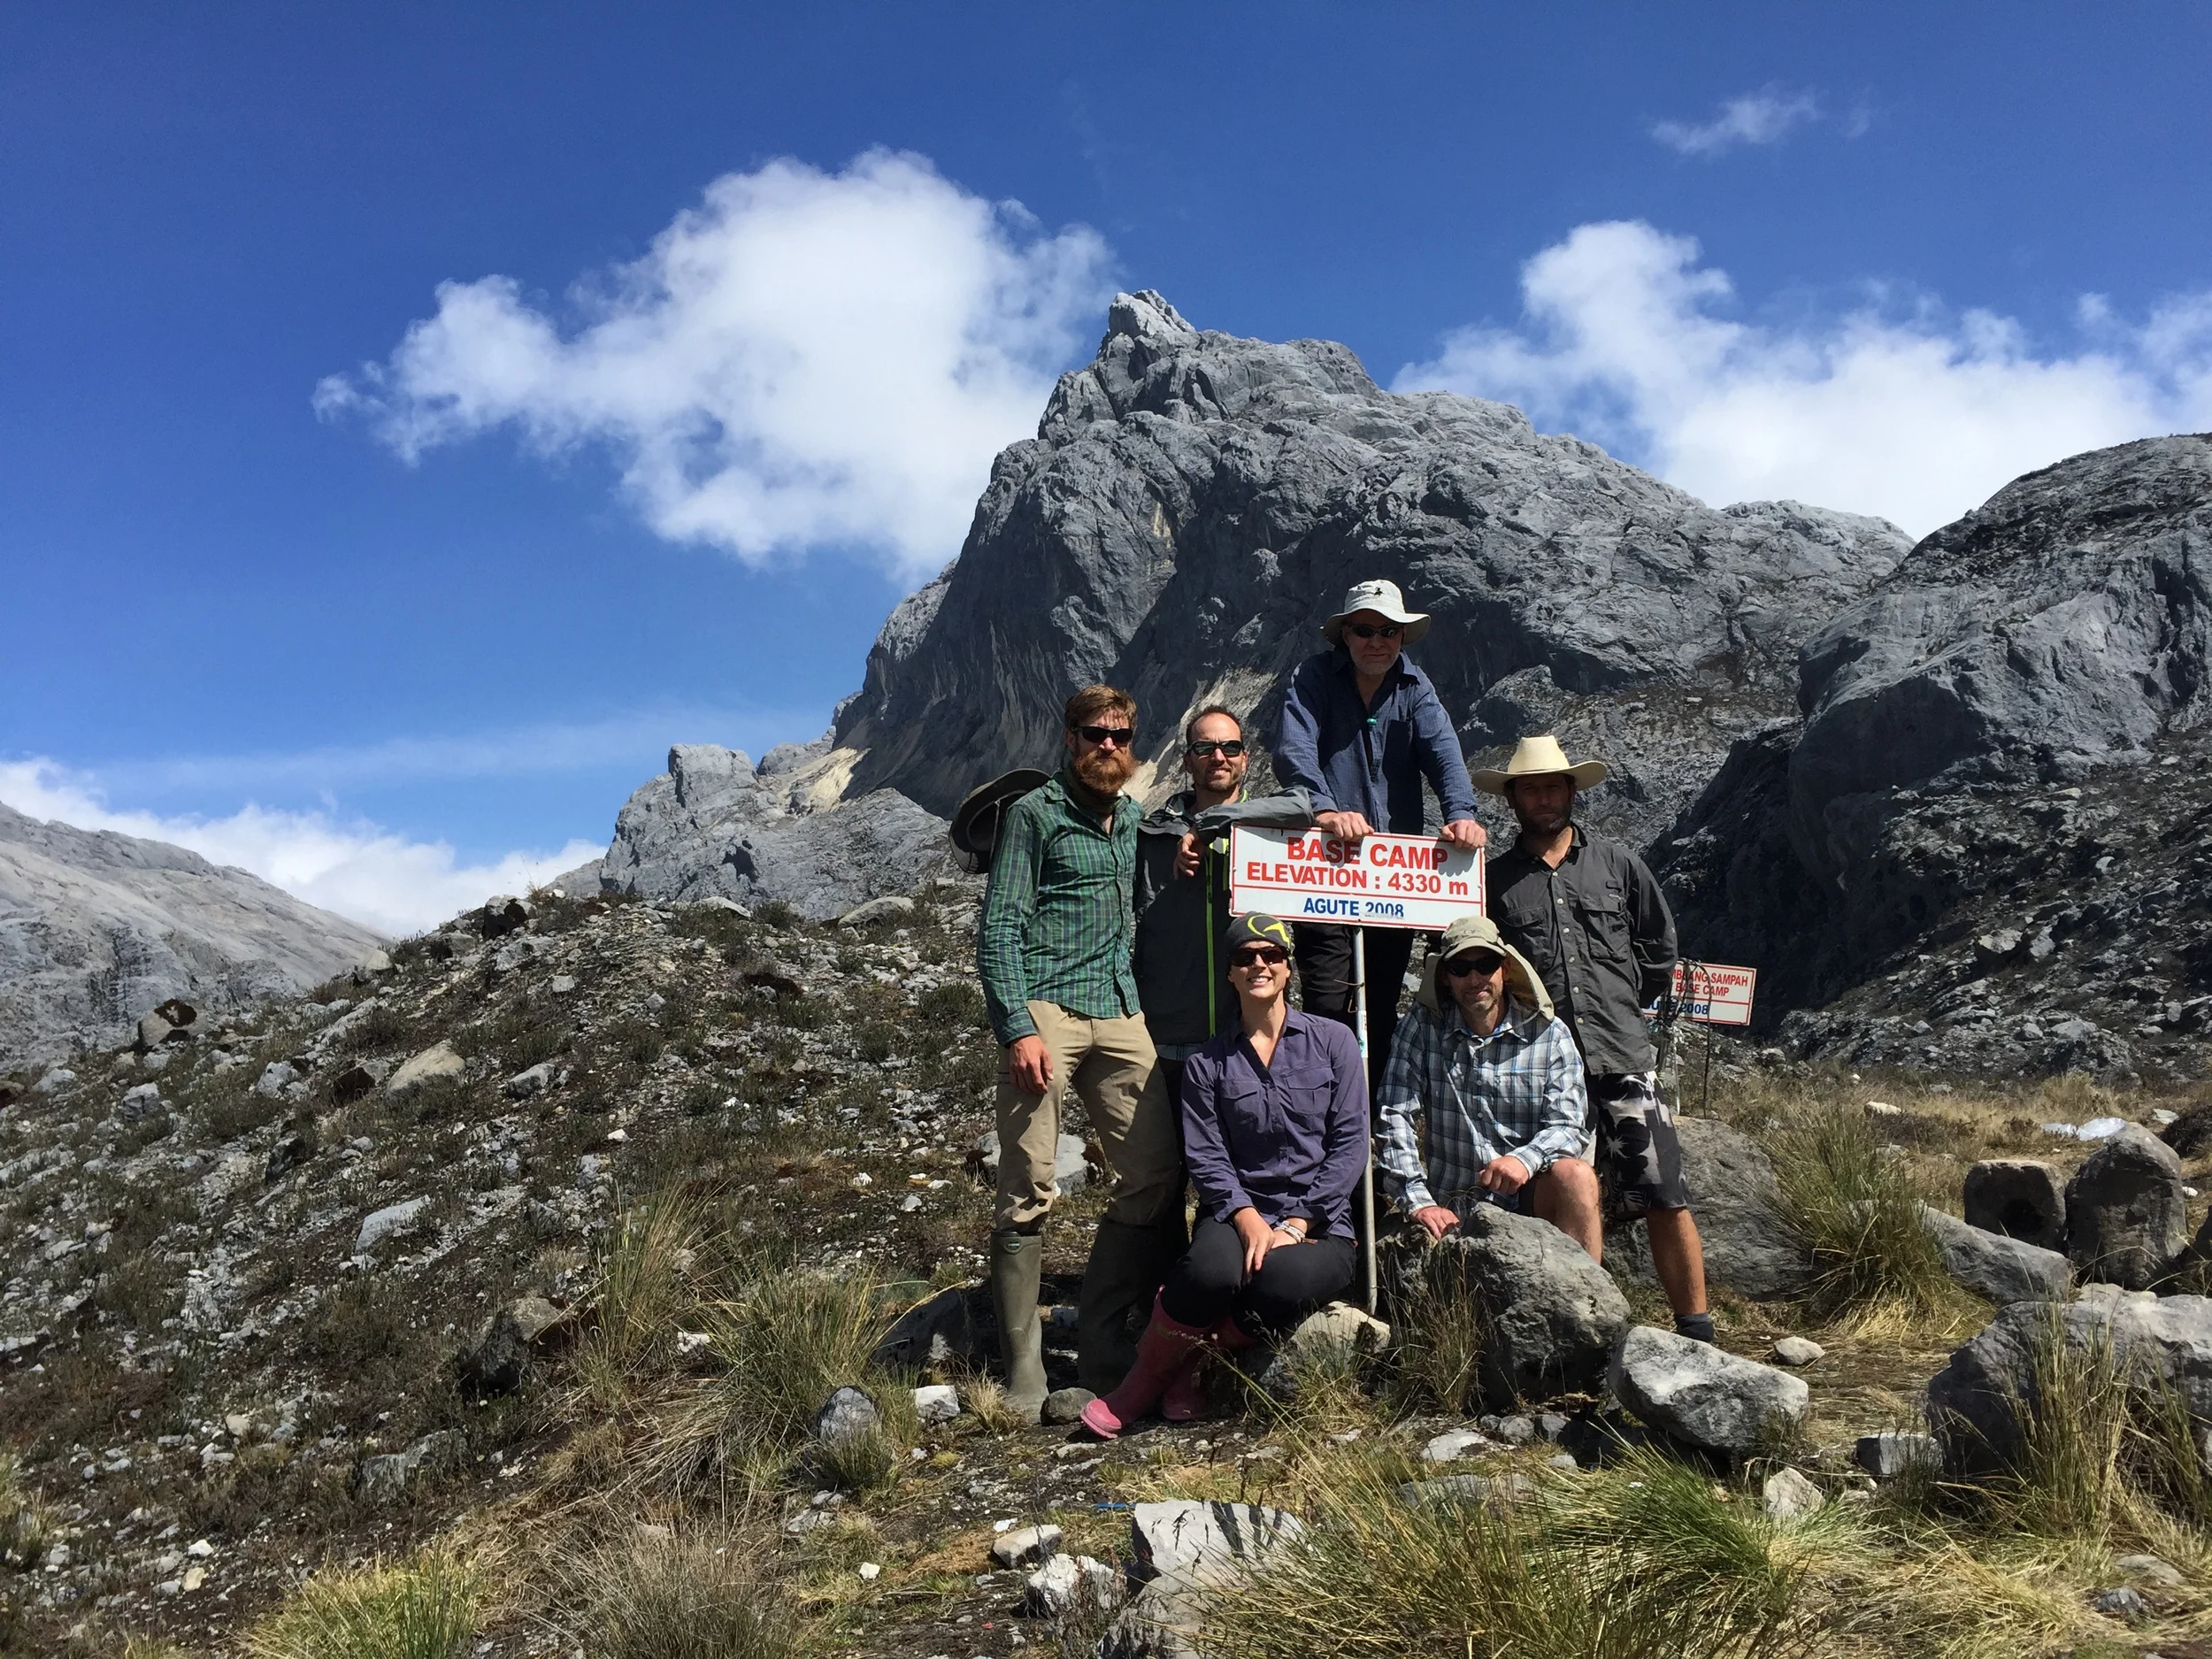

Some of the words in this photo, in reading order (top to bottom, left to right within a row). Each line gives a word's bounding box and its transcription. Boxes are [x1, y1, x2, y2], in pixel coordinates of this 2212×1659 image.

[1287, 836, 1361, 864] BASE
[1370, 843, 1448, 871] CAMP
[1247, 862, 1367, 888] ELEVATION
[1374, 875, 1381, 890] :
[1387, 872, 1442, 894] 4330
[1448, 879, 1469, 895] m
[1303, 897, 1360, 916] AGUTE
[1365, 902, 1405, 918] 2008
[1710, 972, 1748, 987] SAMPAH
[1675, 982, 1701, 994] BASE
[1702, 985, 1729, 996] CAMP
[1681, 1002, 1709, 1015] 2008
